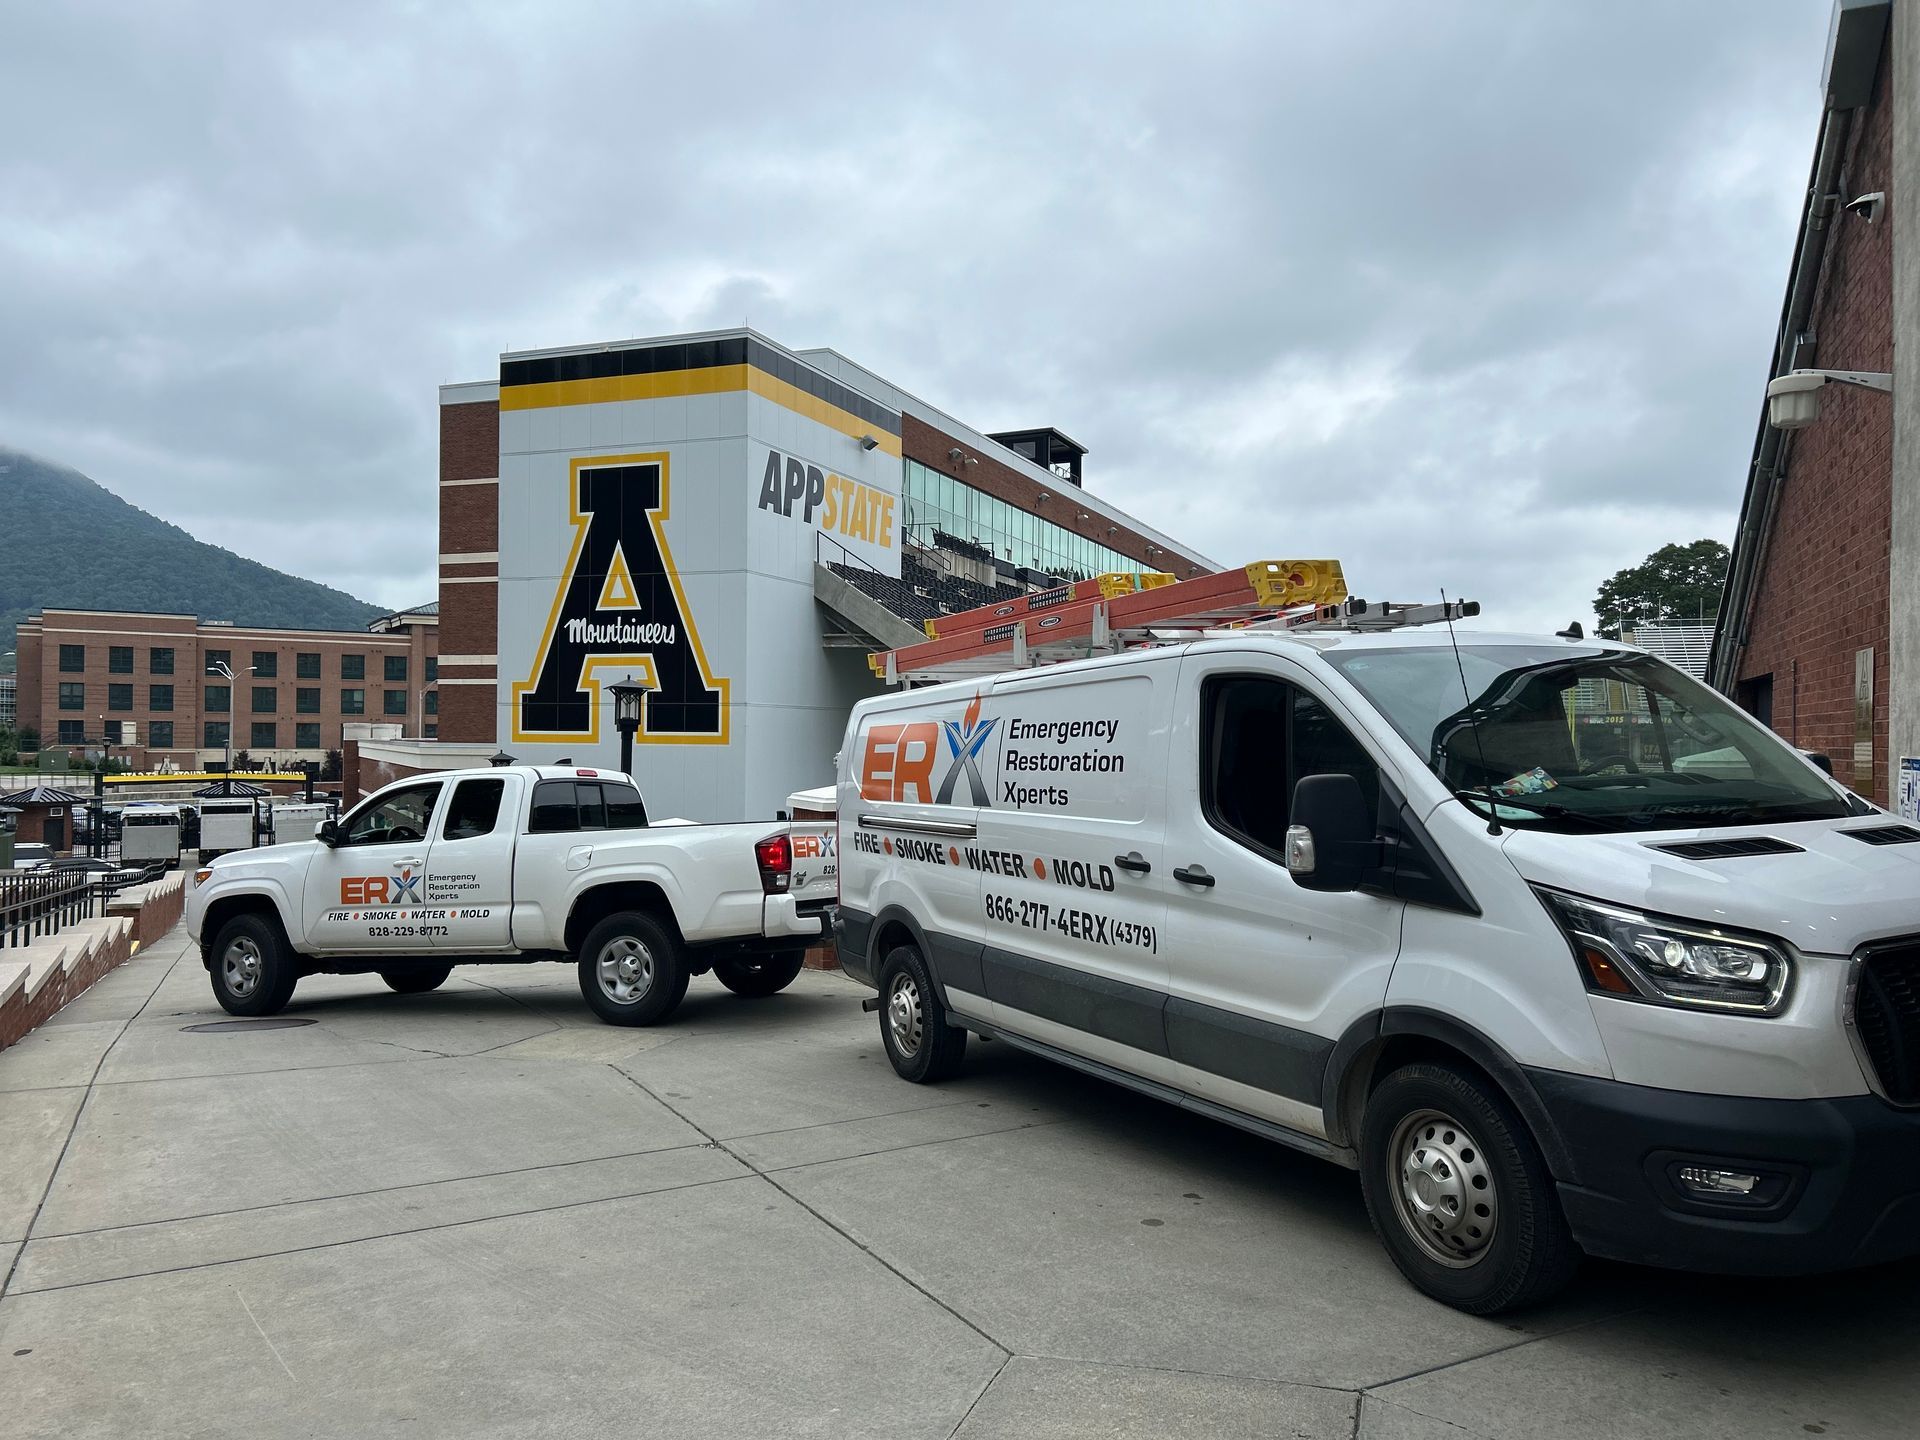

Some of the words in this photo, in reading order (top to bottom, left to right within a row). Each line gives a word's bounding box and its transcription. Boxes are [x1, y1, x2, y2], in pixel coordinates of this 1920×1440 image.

[512, 451, 730, 745] A
[564, 616, 675, 644] Mountaineers
[1009, 718, 1119, 745] Emergency
[1605, 716, 1624, 724] 2015
[860, 717, 1000, 807] ERX
[1005, 749, 1125, 773] Restoration
[1004, 781, 1068, 809] Xperts
[792, 836, 835, 857] ERX
[853, 832, 880, 855] FIRE
[895, 838, 946, 865] SMOKE
[965, 847, 1028, 879] WATER
[1053, 858, 1115, 892] MOLD
[341, 875, 422, 904] ERX
[428, 874, 476, 883] Emergency
[428, 893, 459, 901] Xperts
[328, 912, 349, 921] FIRE
[362, 911, 397, 920] SMOKE
[411, 910, 446, 919] WATER
[460, 909, 490, 918] MOLD
[368, 926, 448, 936] 828-229-8772
